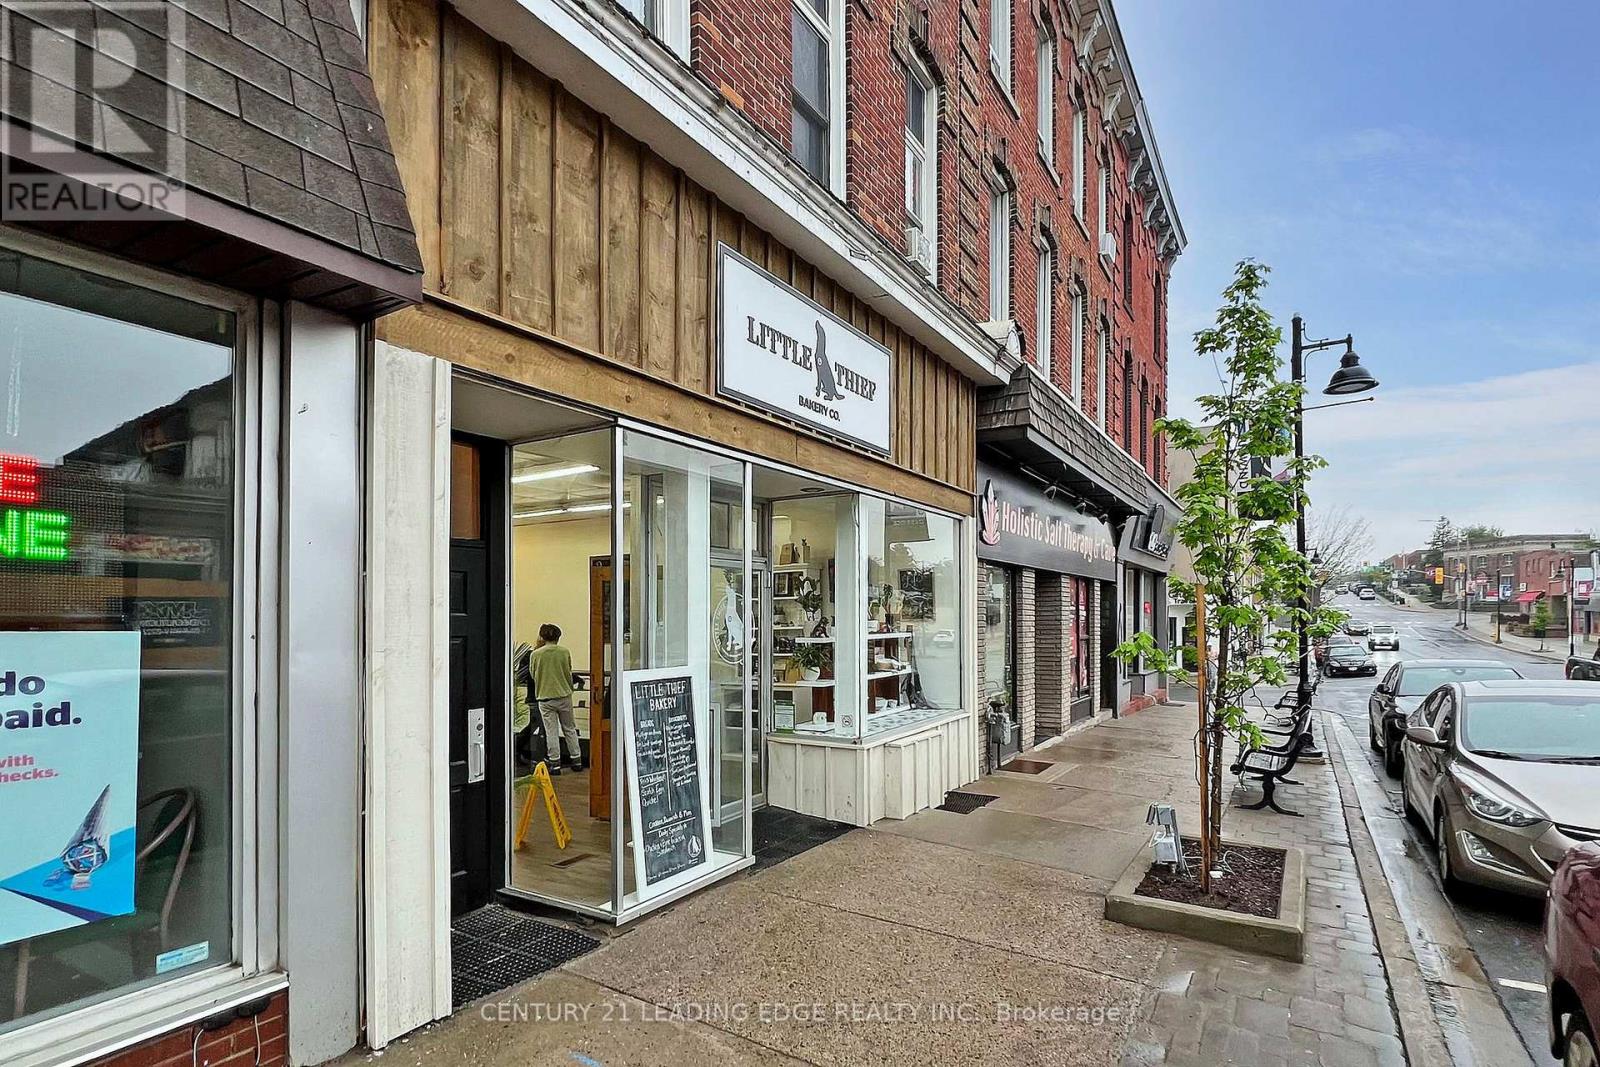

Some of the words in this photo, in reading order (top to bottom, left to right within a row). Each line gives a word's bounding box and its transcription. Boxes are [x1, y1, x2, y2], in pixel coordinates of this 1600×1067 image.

[746, 316, 812, 371] LITTLE
[834, 361, 876, 401] THIEF
[798, 395, 829, 416] BAKERY
[828, 407, 841, 422] CO.
[1002, 501, 1043, 541] Holistic
[1044, 515, 1062, 547] Salt
[1063, 523, 1093, 562] Therapy
[634, 683, 664, 699] LITTLE
[665, 680, 687, 695] THIEF
[0, 702, 82, 730] aid.
[649, 696, 677, 711] BAKERY
